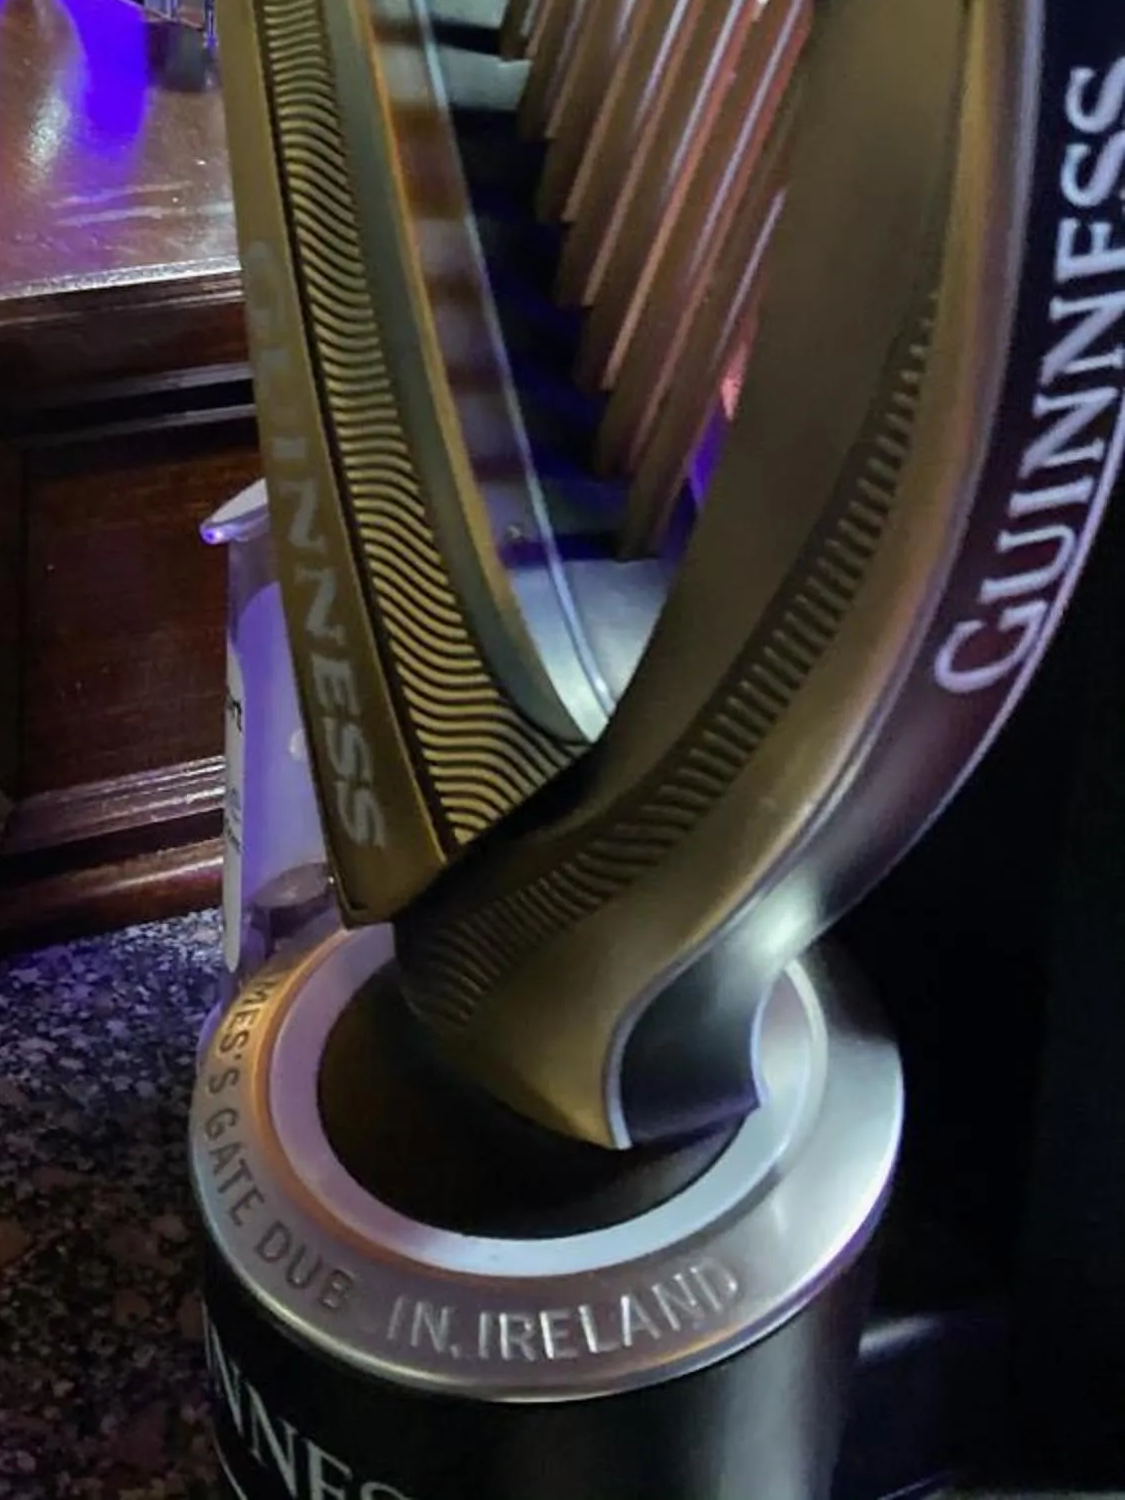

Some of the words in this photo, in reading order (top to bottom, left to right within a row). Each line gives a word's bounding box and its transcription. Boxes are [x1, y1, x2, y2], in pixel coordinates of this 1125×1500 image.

[935, 56, 1125, 694] GUINNESS
[202, 1107, 267, 1228] GATE
[477, 1255, 741, 1362] IRELAND
